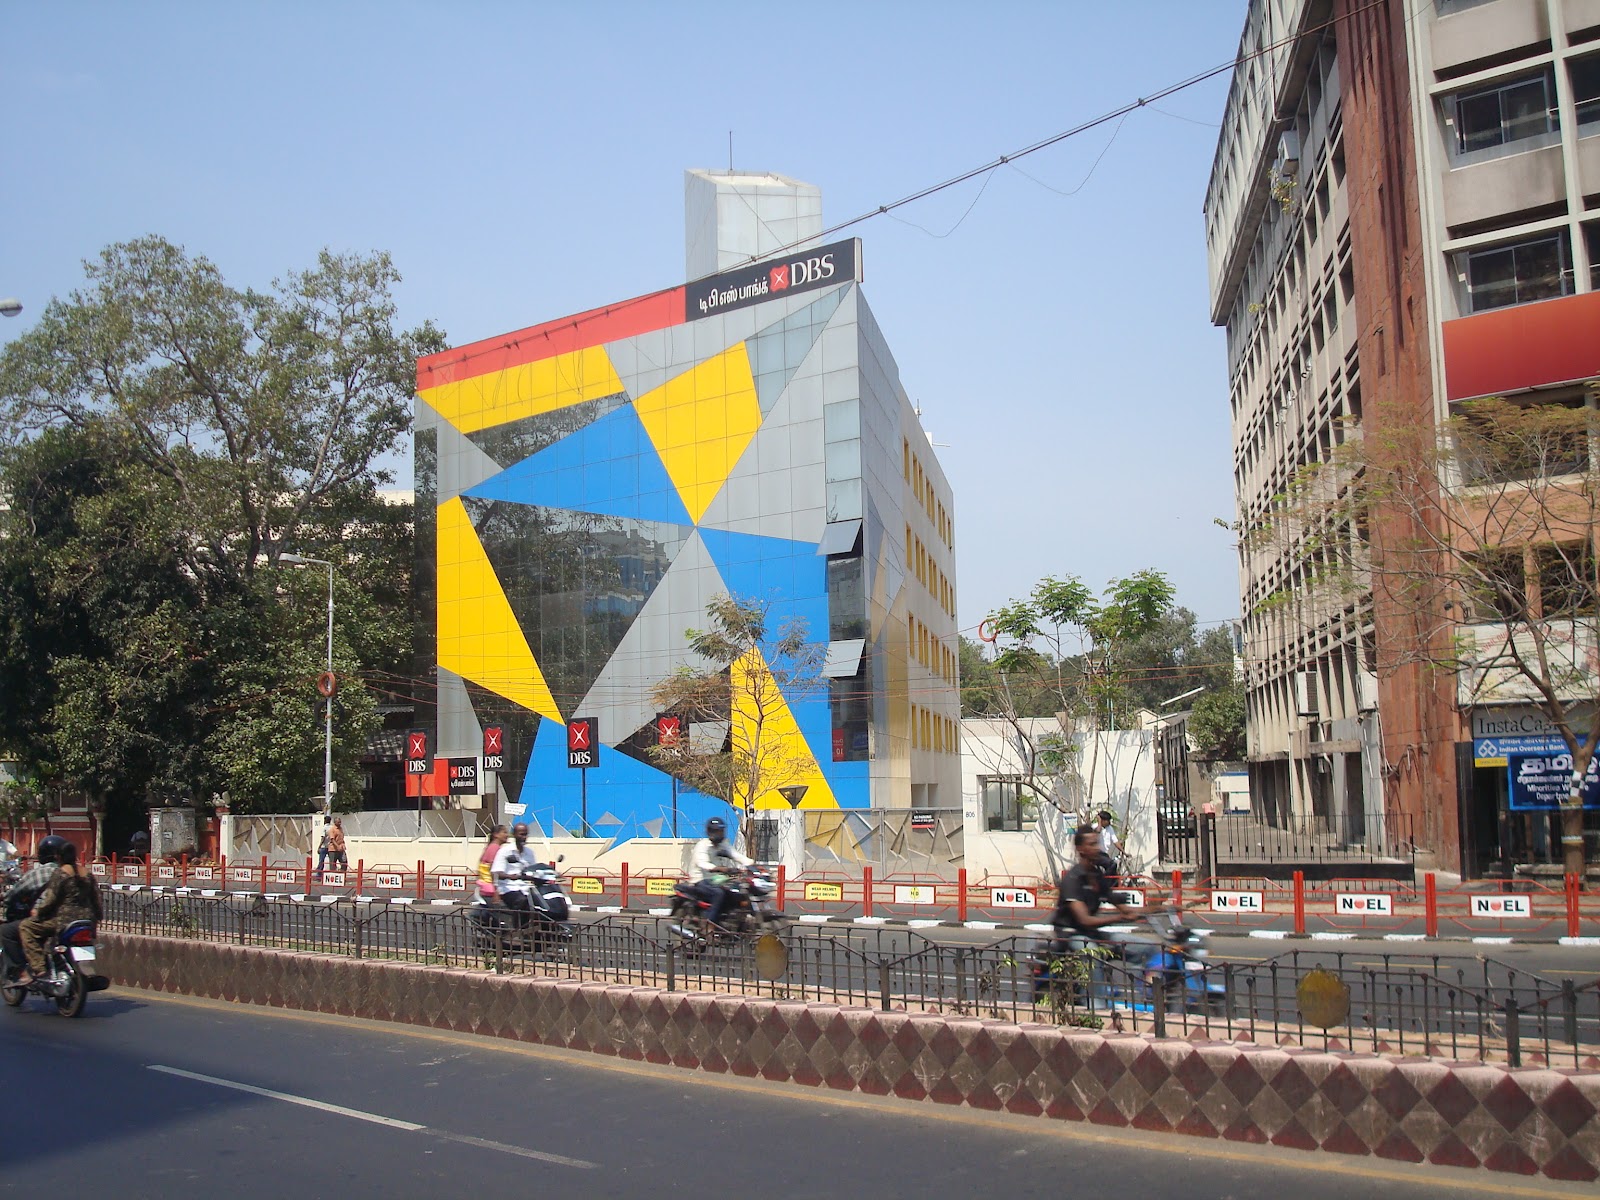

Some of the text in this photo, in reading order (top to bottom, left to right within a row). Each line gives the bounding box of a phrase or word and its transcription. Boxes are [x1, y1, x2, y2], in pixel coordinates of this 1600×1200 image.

[790, 253, 835, 287] DBS
[484, 755, 503, 768] DBS
[571, 751, 591, 765] DBS
[409, 760, 426, 772] DBS
[458, 766, 475, 778] DBS
[125, 867, 138, 875] NOEL
[160, 868, 173, 876] NOEL
[196, 869, 211, 877] NOEL
[236, 870, 250, 879] NOEL
[278, 872, 294, 881] NOEL
[325, 875, 343, 884] NOEL
[378, 876, 400, 886] NOEL
[441, 878, 463, 888] NOEL
[996, 891, 1031, 903] NOEL
[1217, 896, 1258, 908] NOEL
[1342, 898, 1386, 911] NOEL
[1477, 900, 1525, 912] NOEL
